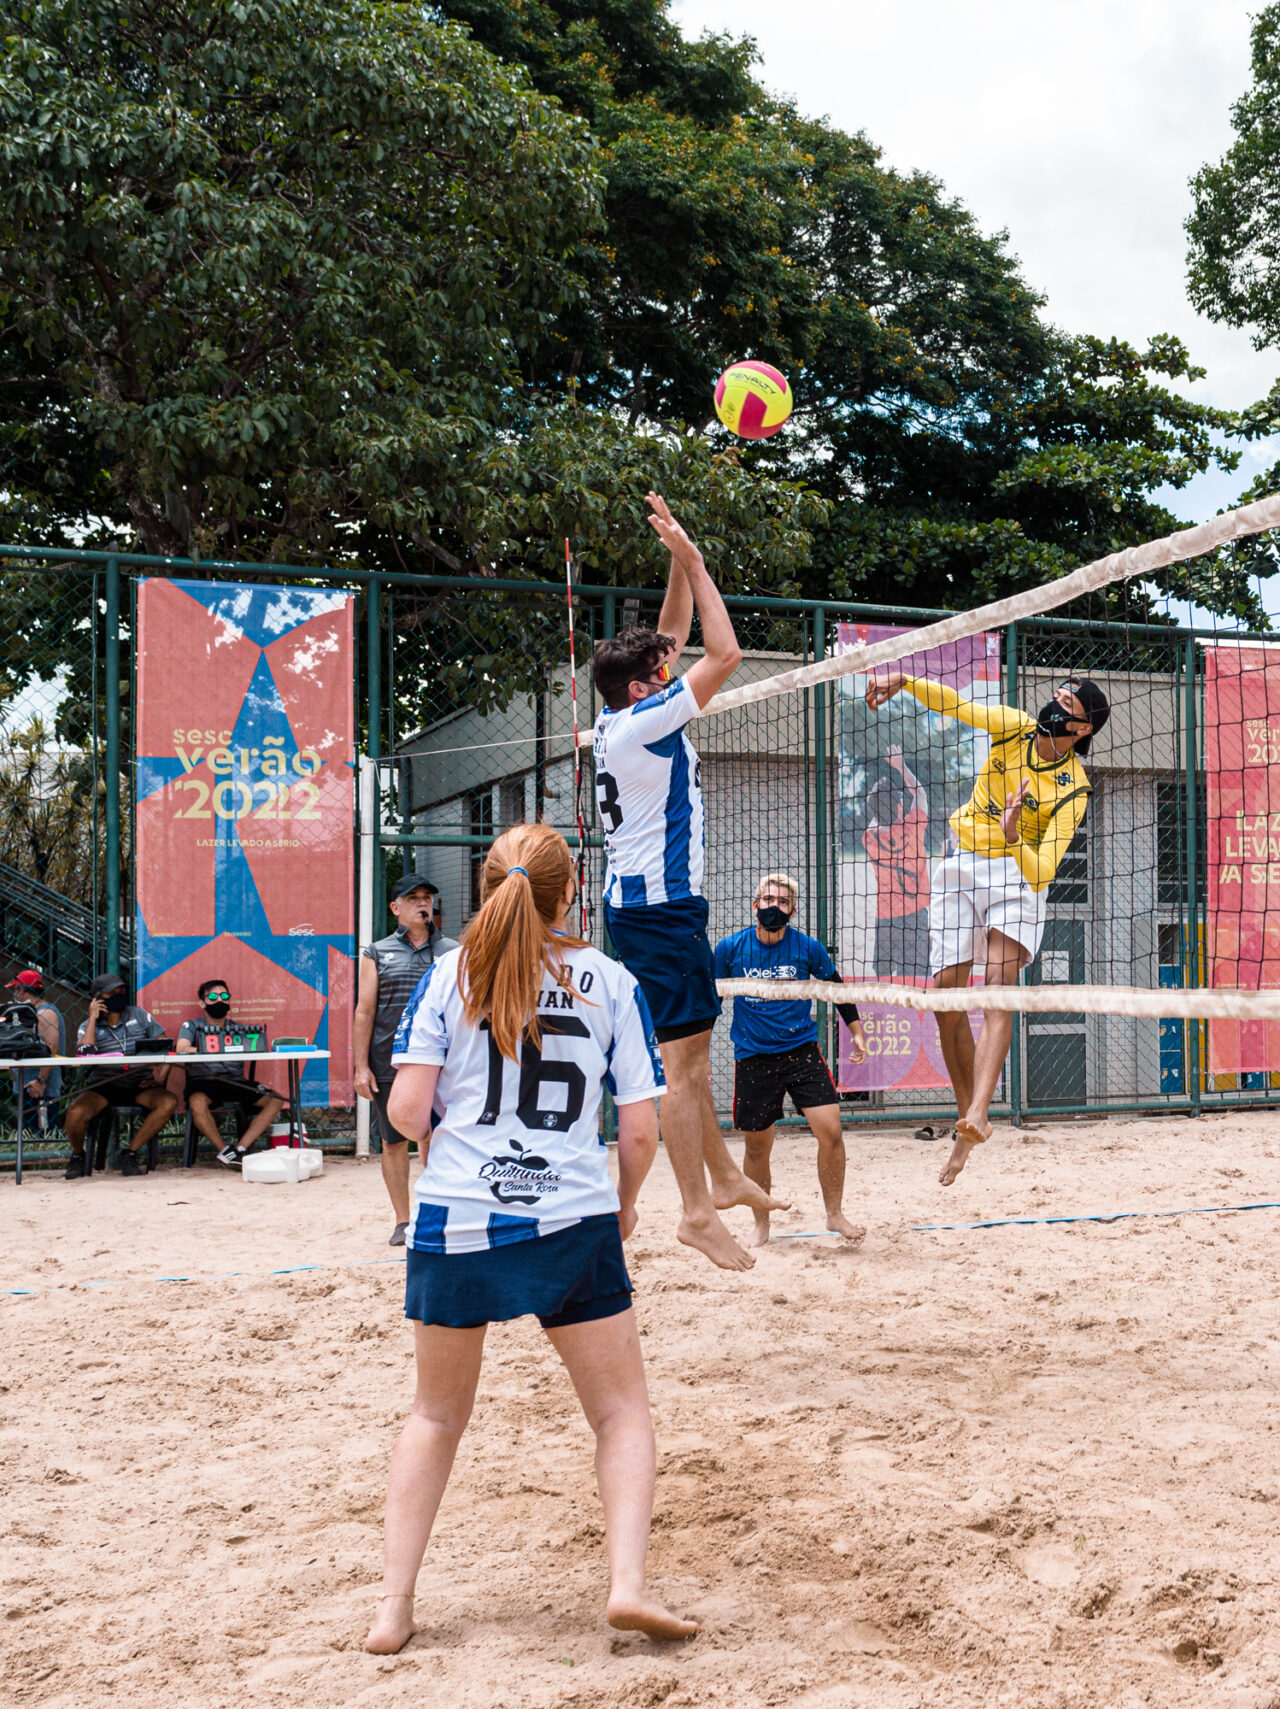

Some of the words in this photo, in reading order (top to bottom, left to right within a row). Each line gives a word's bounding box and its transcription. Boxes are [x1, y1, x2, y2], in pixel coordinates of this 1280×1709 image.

[1246, 720, 1271, 728] sesc
[172, 728, 232, 745] sesc
[174, 736, 321, 776] verão
[173, 780, 323, 820] 2022
[196, 838, 226, 848] LAZER
[227, 838, 263, 848] LEVADO
[264, 838, 272, 848] A
[1219, 864, 1243, 885] A
[863, 1014, 912, 1034] erão
[205, 1034, 220, 1052] 8
[246, 1033, 260, 1052] 7
[850, 1036, 912, 1057] 022
[476, 1013, 591, 1132] 16
